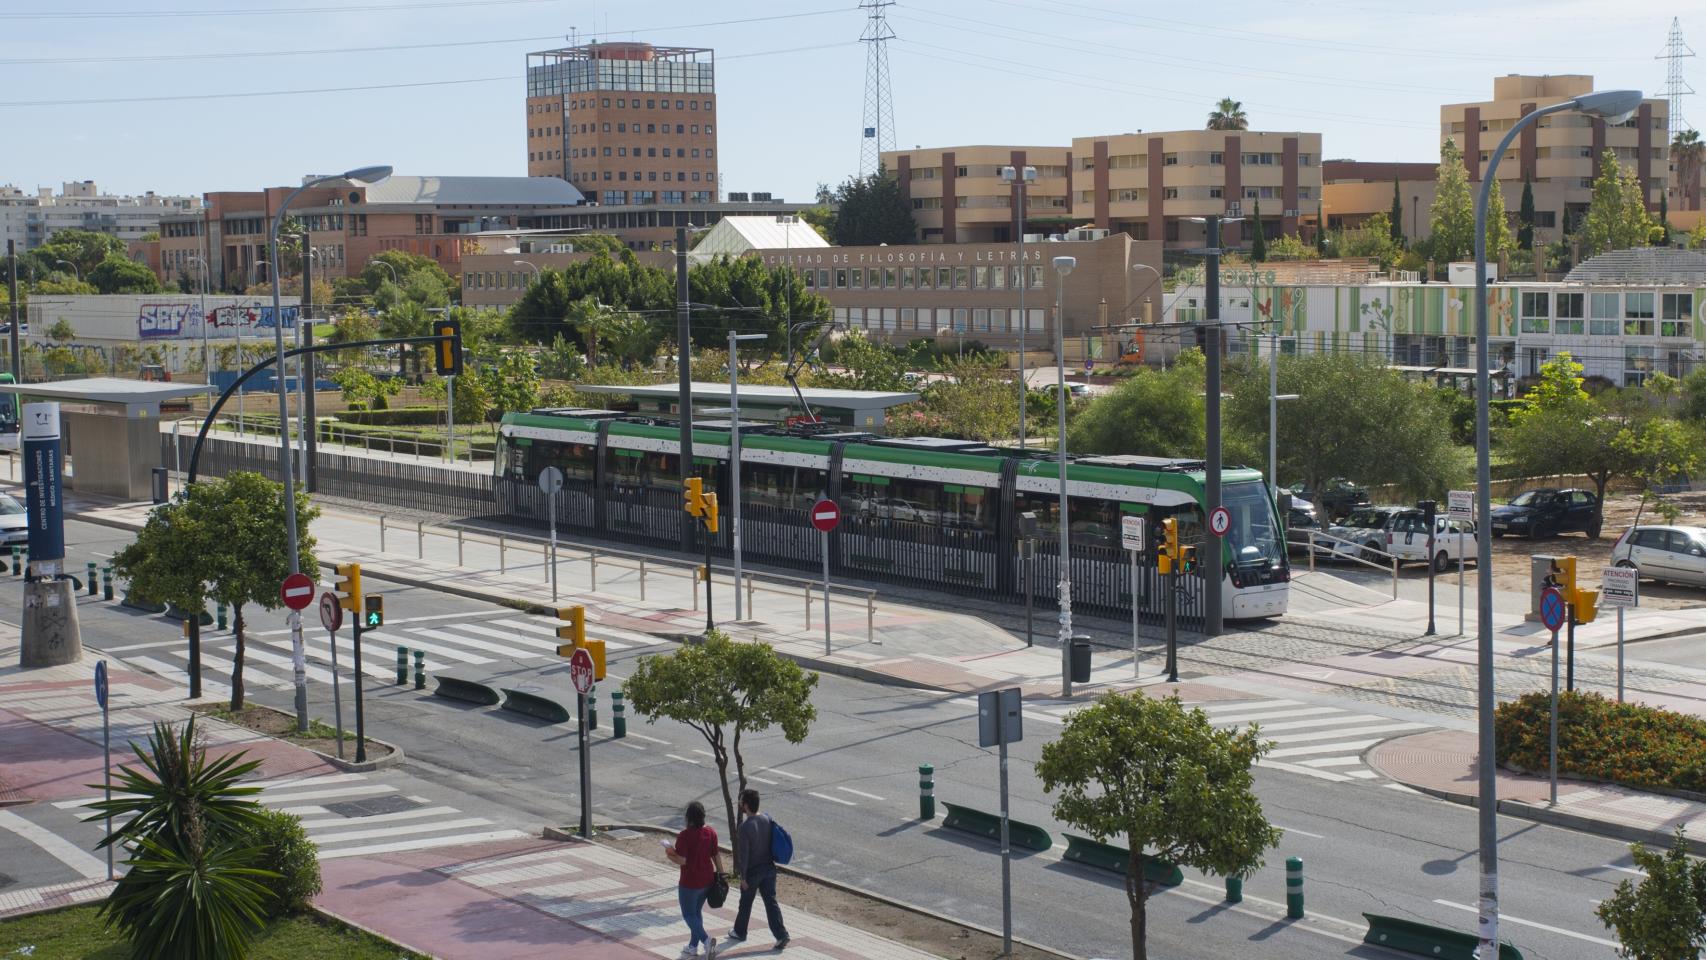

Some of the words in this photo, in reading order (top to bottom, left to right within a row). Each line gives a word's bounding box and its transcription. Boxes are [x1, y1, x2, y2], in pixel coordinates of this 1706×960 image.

[759, 254, 822, 264] ACULTAD
[833, 254, 848, 263] DE
[860, 251, 945, 263] FILOSOFÍA
[958, 252, 963, 261] Y
[976, 250, 1041, 261] LETRAS
[36, 450, 45, 498] INVESTIGACIONES
[1604, 570, 1633, 578] ATENCIÓN
[572, 664, 592, 676] STOP
